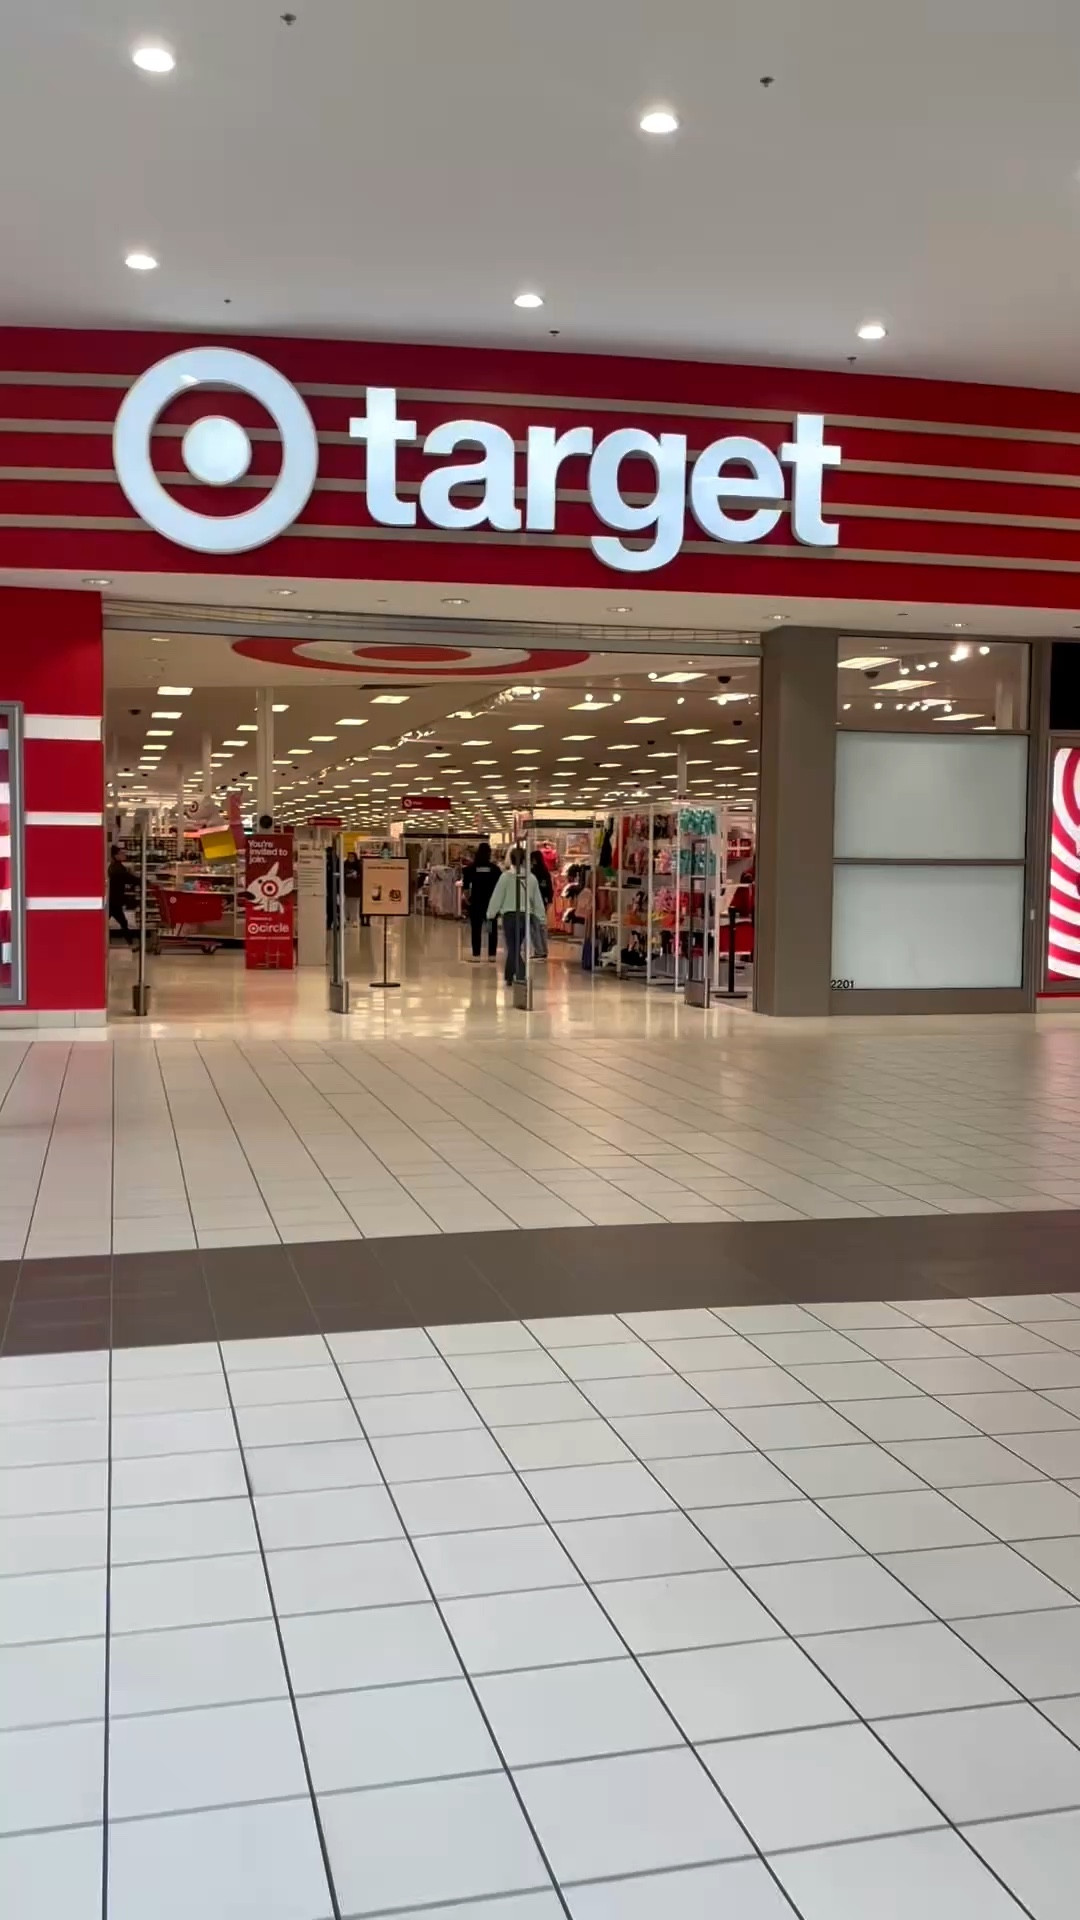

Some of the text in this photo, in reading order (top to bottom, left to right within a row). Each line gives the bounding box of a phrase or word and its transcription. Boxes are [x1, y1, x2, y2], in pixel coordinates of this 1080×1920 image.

[349, 386, 842, 573] target
[248, 840, 273, 848] You're
[259, 922, 289, 933] circle
[830, 979, 854, 989] 2201
